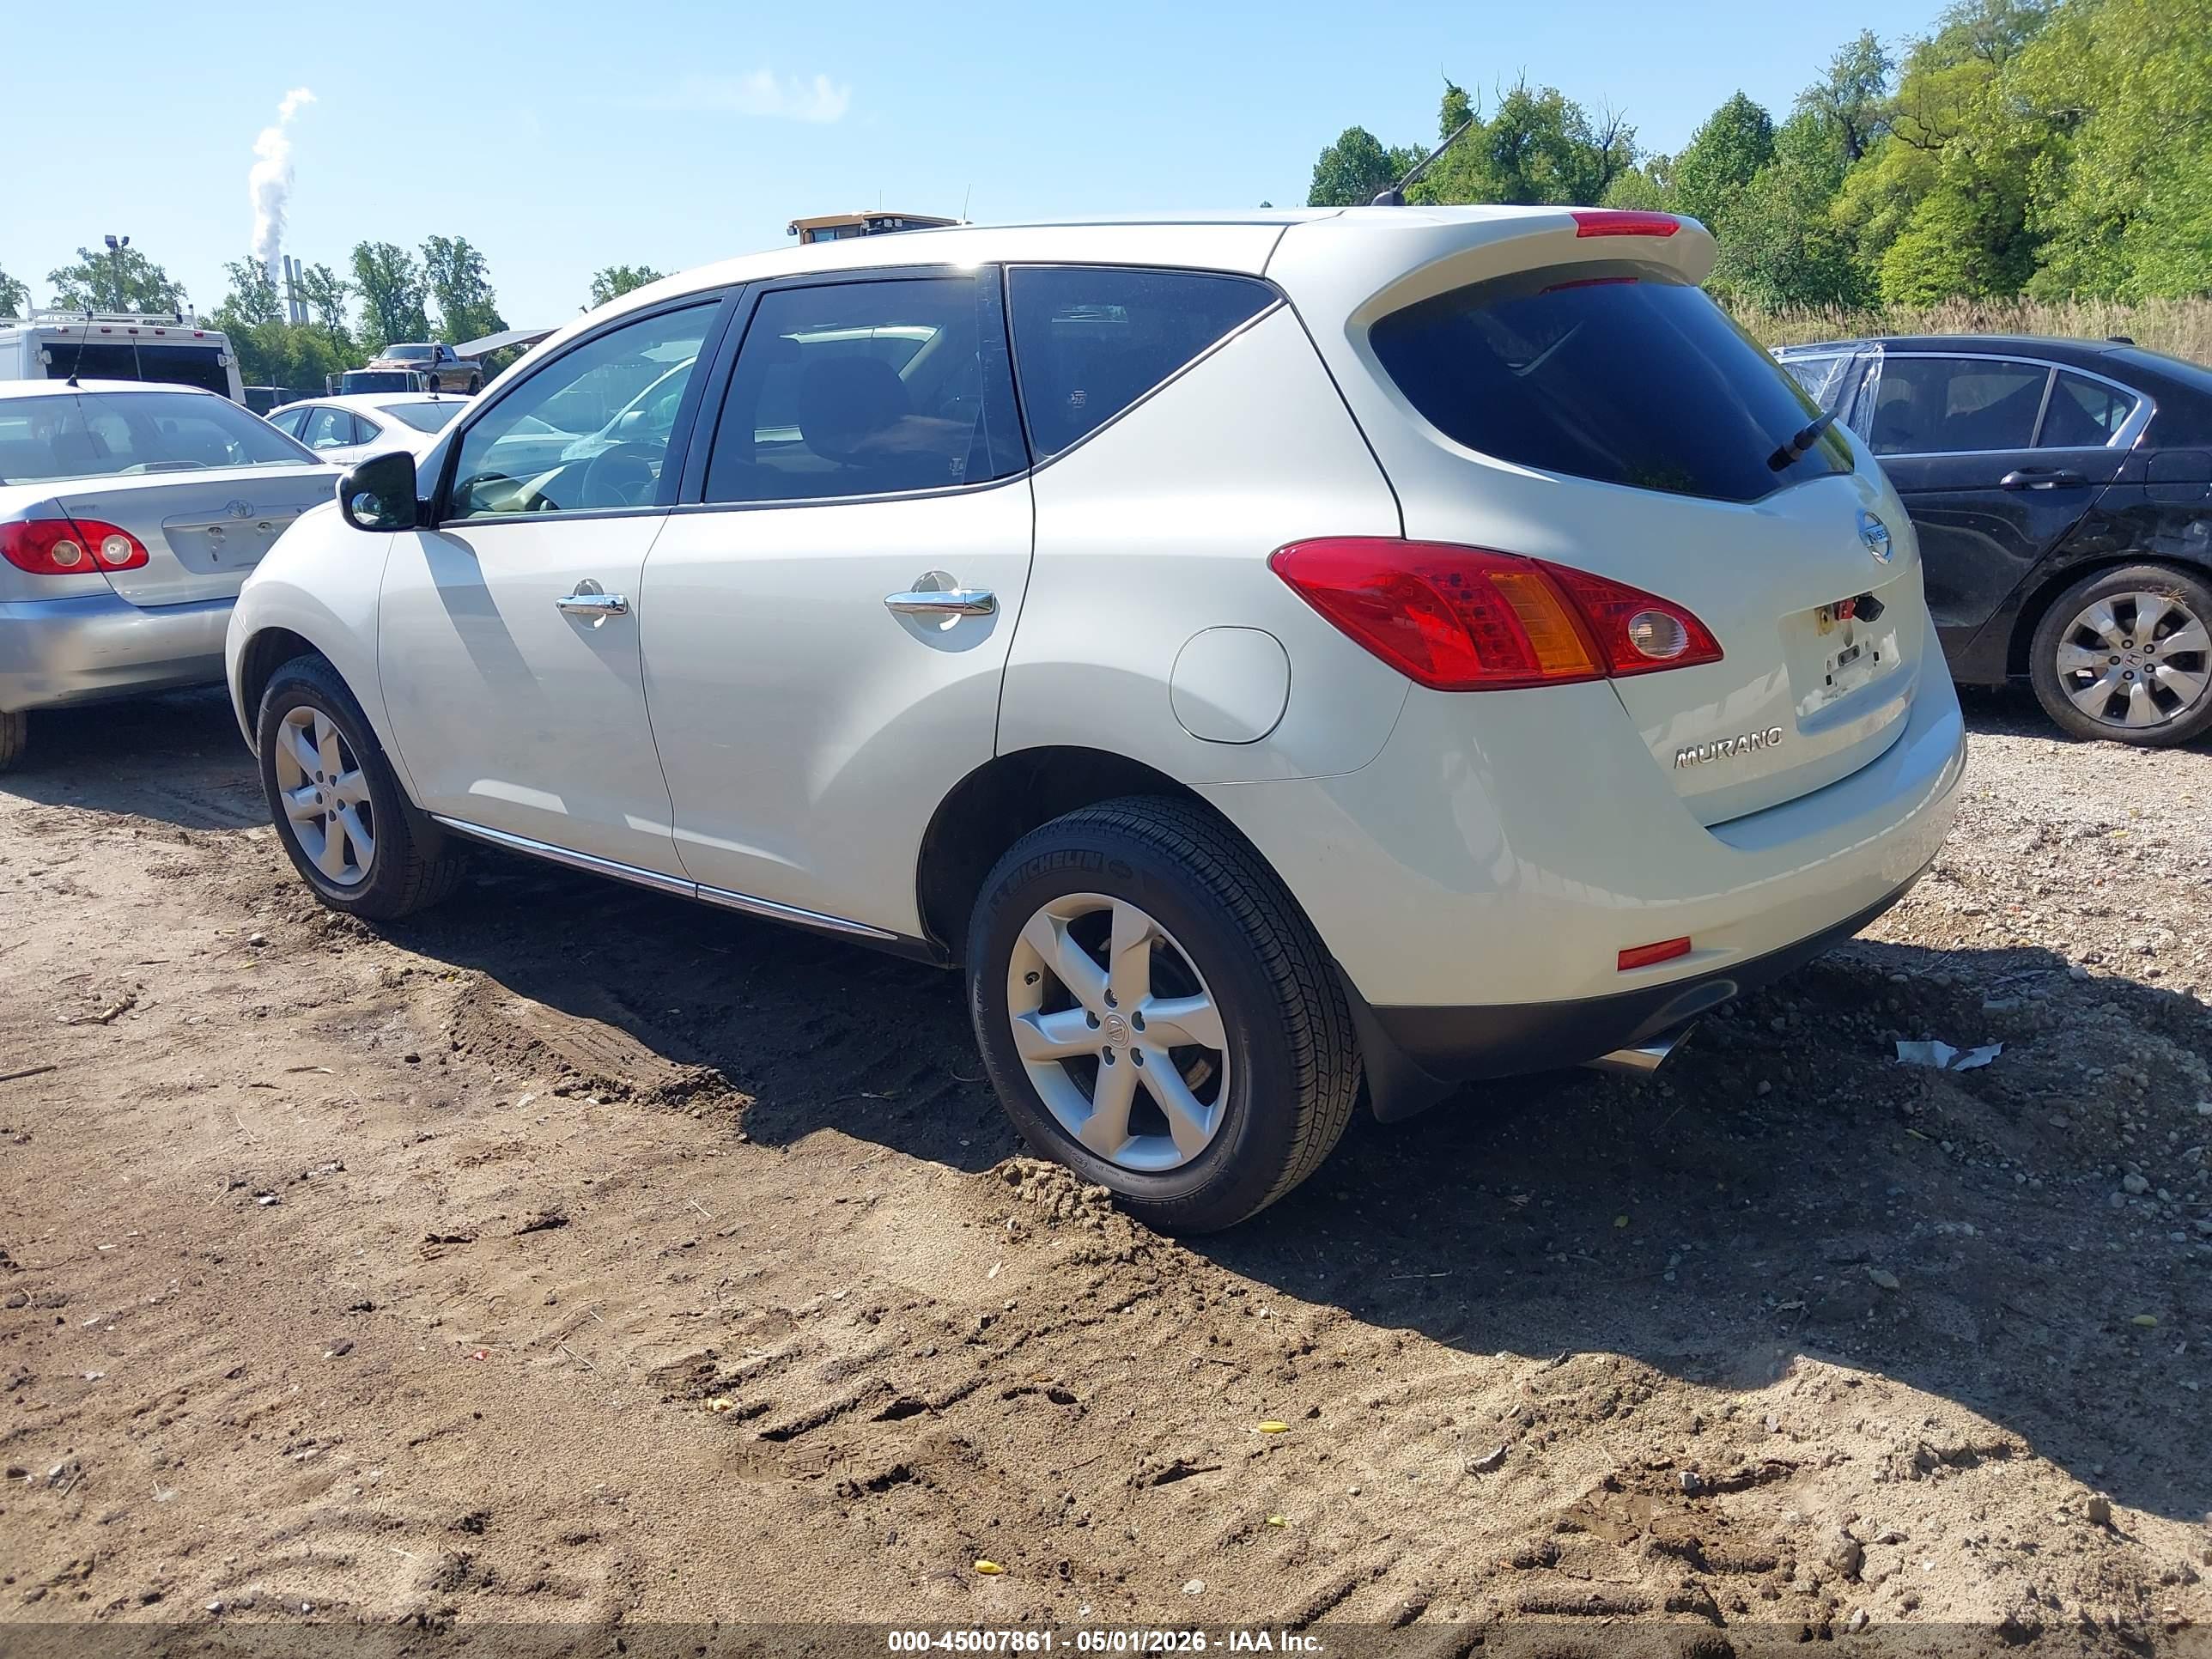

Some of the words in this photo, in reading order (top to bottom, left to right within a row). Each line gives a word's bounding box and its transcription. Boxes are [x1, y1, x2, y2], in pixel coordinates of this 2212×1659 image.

[1868, 529, 1887, 544] NISS
[1674, 726, 1784, 769] MURANO
[1006, 849, 1104, 894] MICHELIN
